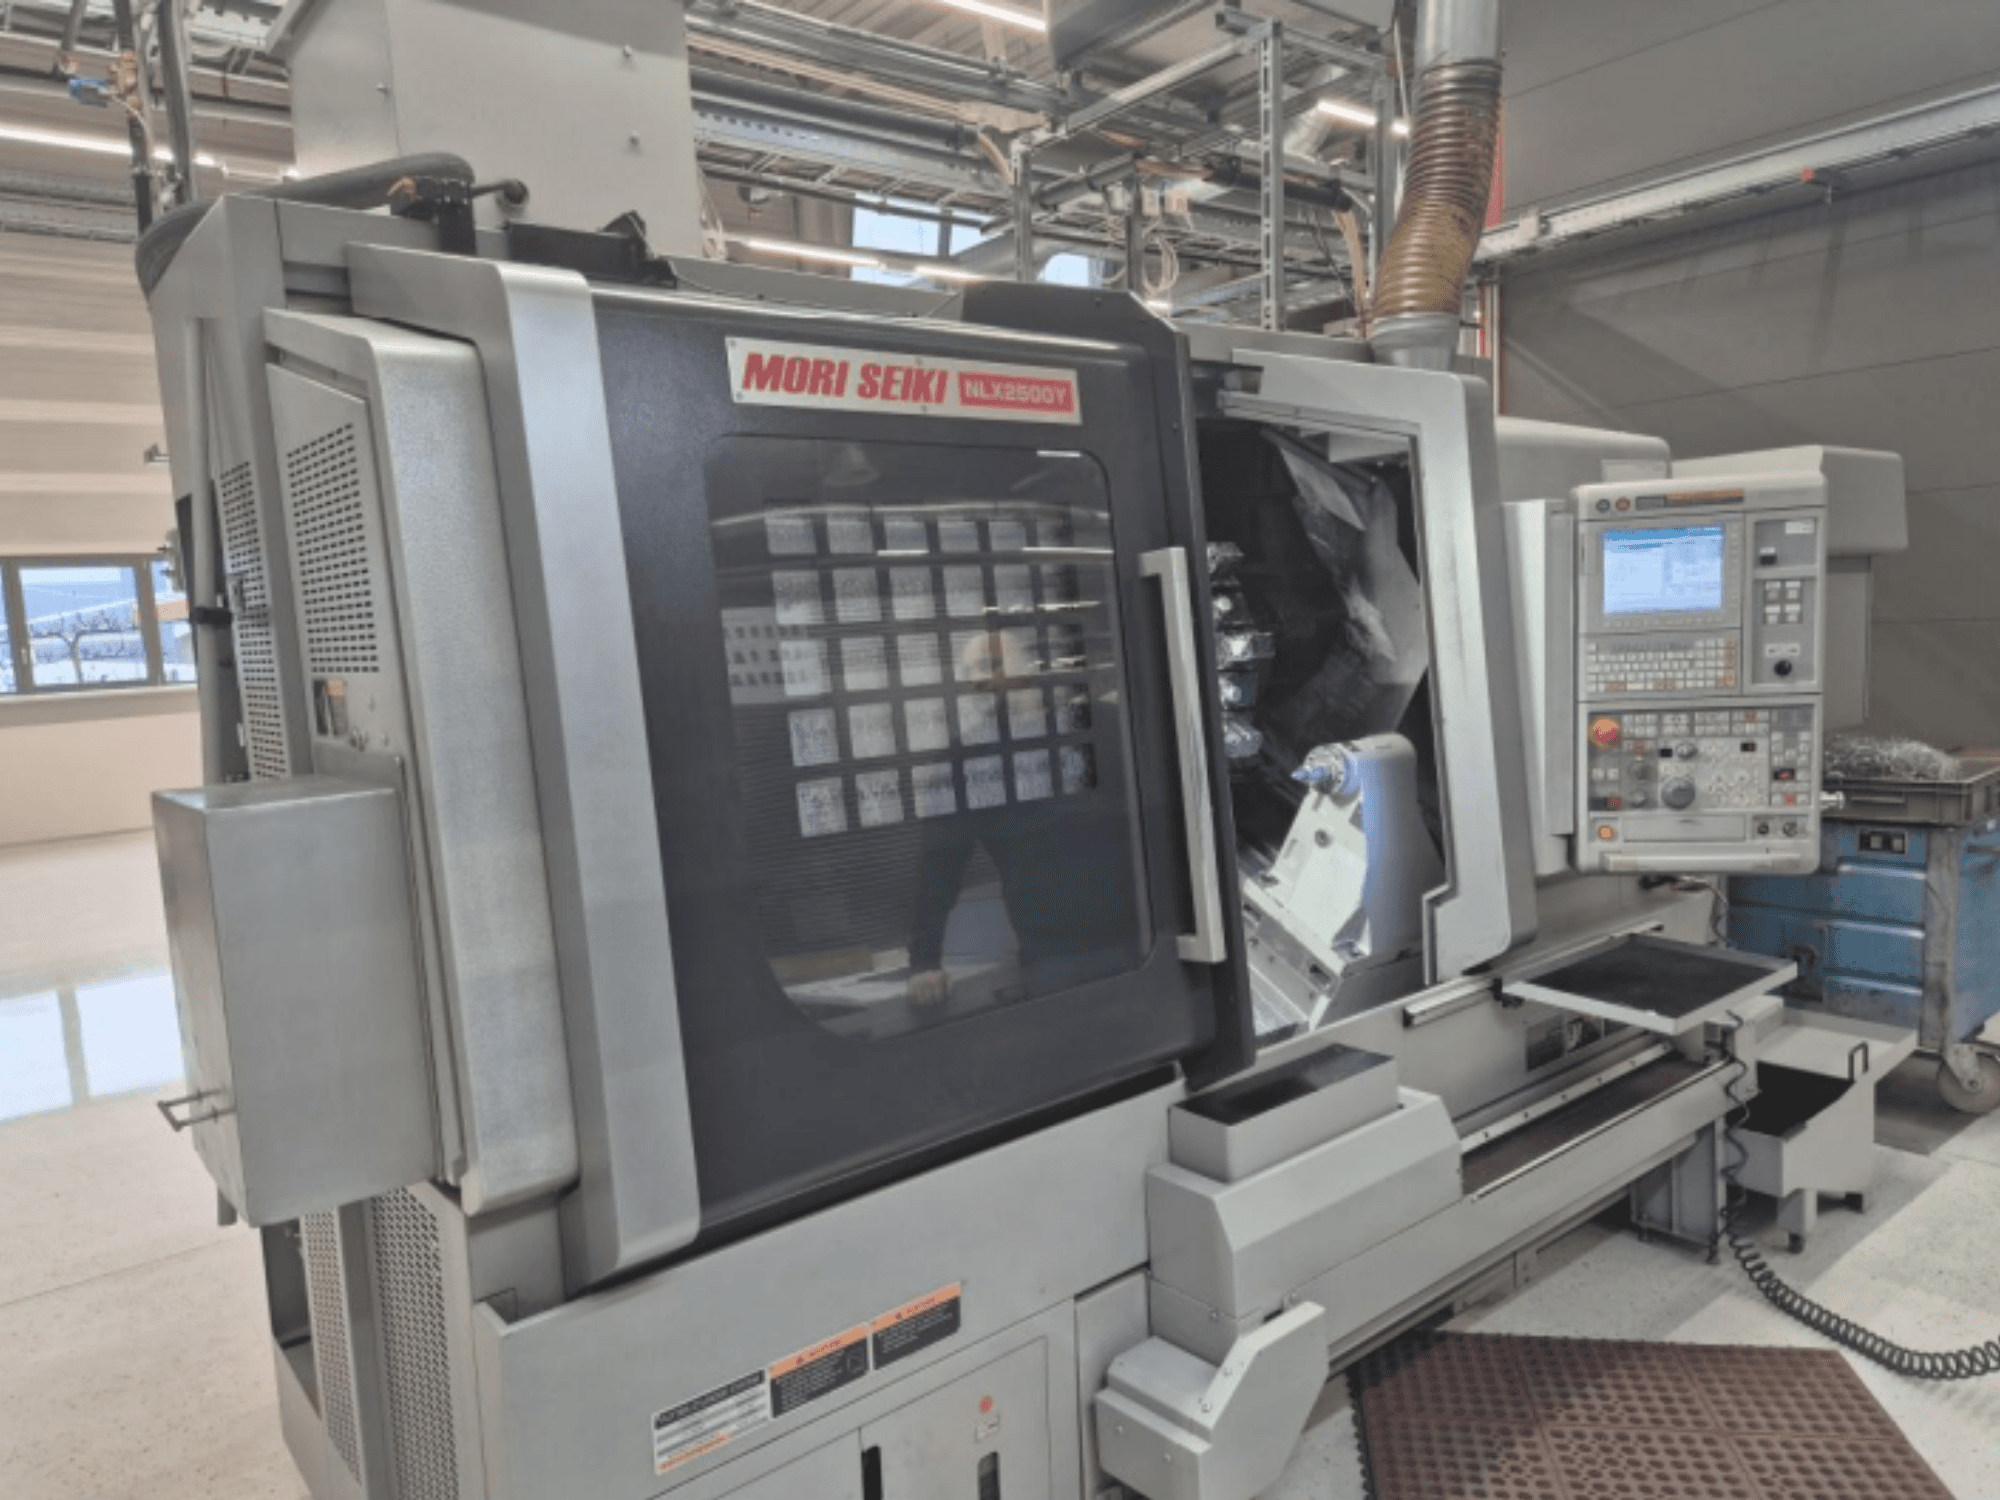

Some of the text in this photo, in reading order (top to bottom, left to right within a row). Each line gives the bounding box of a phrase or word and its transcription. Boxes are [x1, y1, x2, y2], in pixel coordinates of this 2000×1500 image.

[743, 352, 1067, 406] MORI SEIKI NLX2500Y
